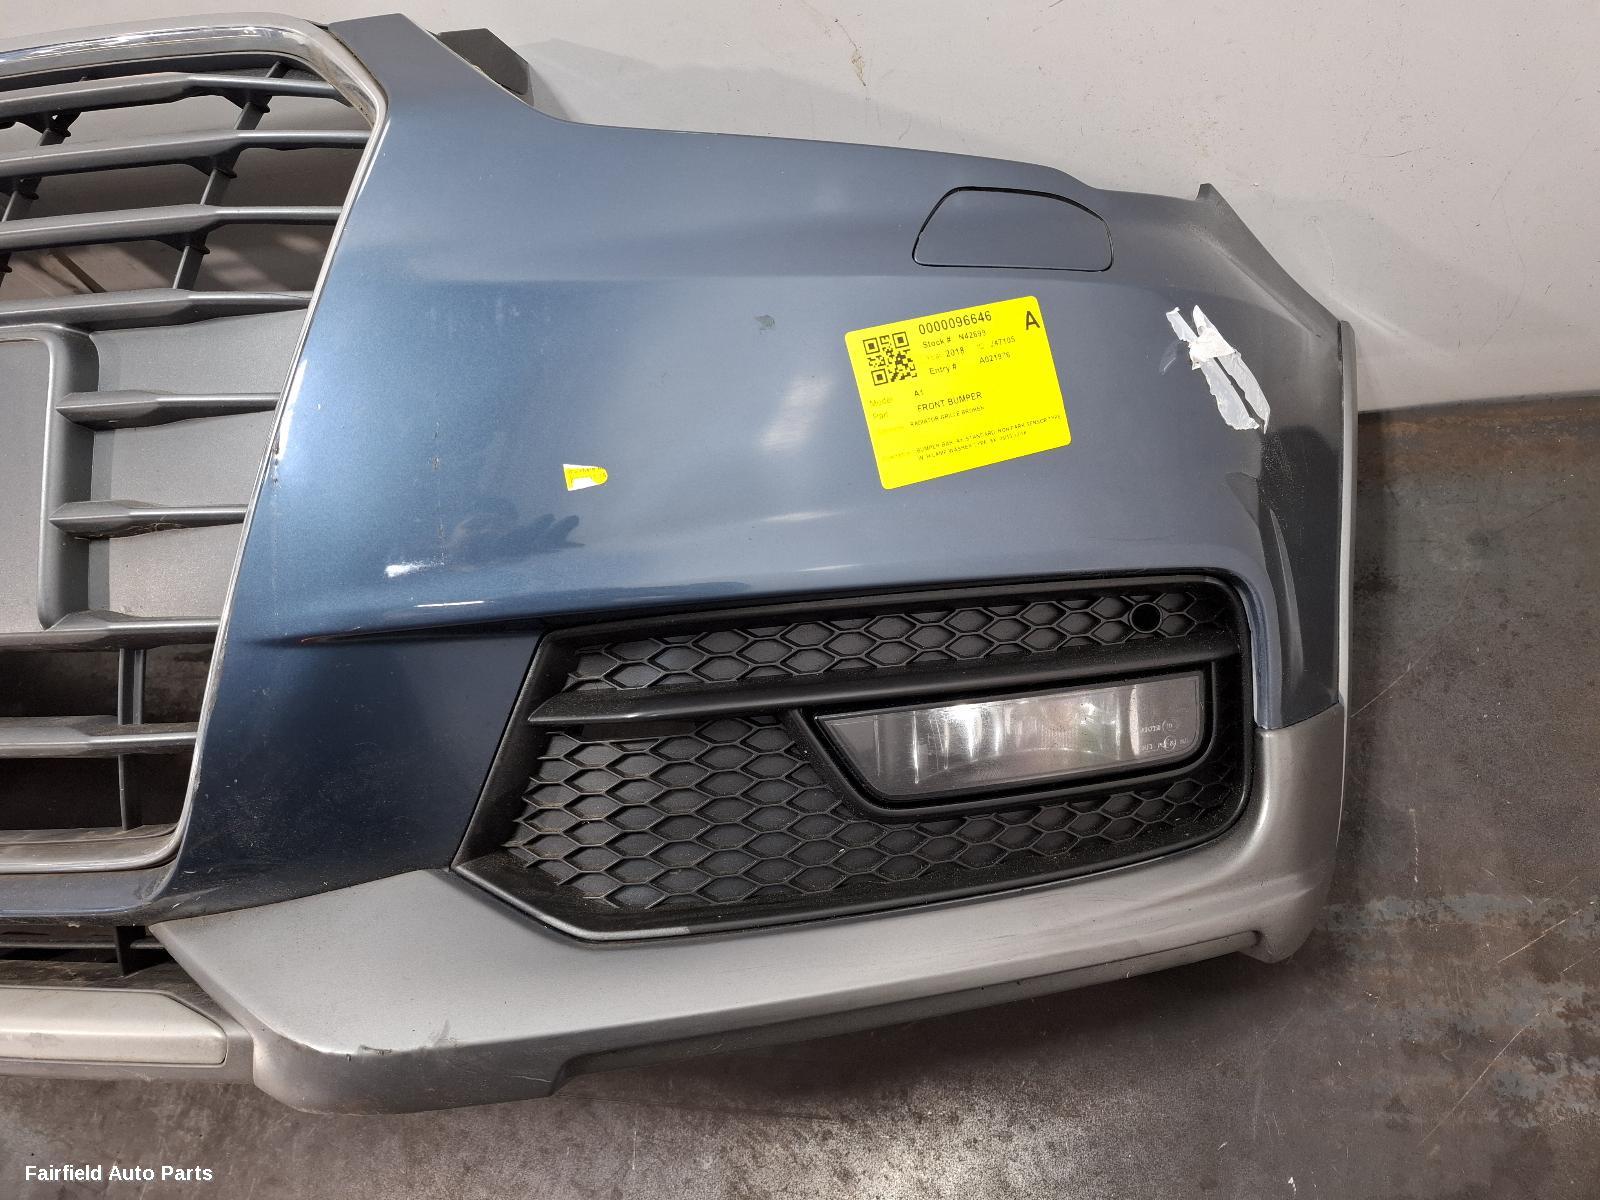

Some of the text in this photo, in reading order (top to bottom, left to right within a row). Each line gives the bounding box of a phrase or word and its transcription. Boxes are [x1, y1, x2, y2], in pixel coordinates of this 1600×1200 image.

[917, 310, 993, 335] 0000096646
[1025, 310, 1041, 331] A
[921, 335, 952, 349] Stock #
[944, 346, 965, 357] 2018
[928, 362, 958, 376] Entry #
[916, 390, 983, 413] FRONT BUMPER
